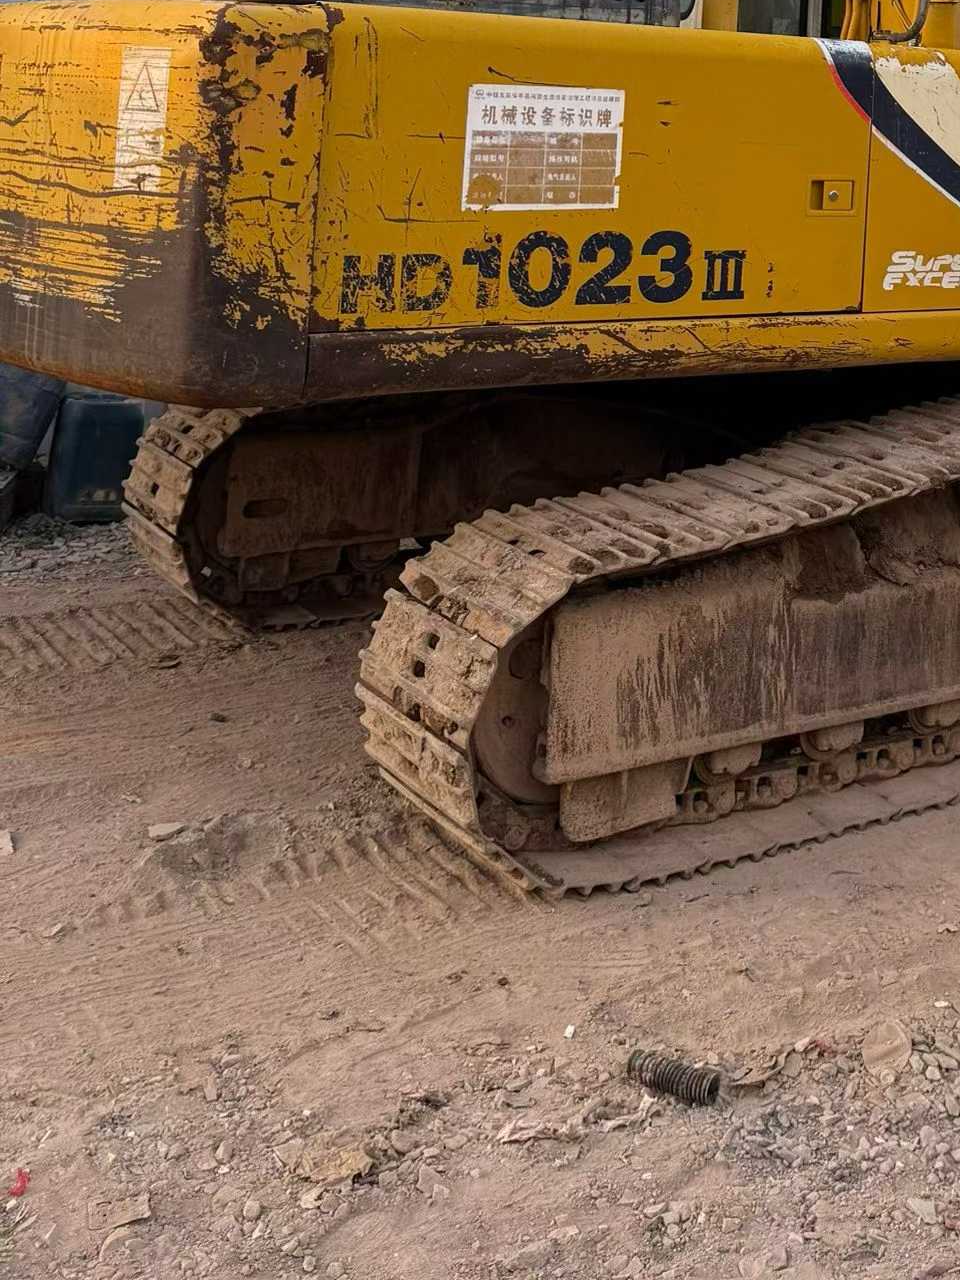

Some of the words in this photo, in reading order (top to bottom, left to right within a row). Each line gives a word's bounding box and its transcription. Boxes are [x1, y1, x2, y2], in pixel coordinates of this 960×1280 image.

[481, 105, 613, 128] 机械设备标识牌
